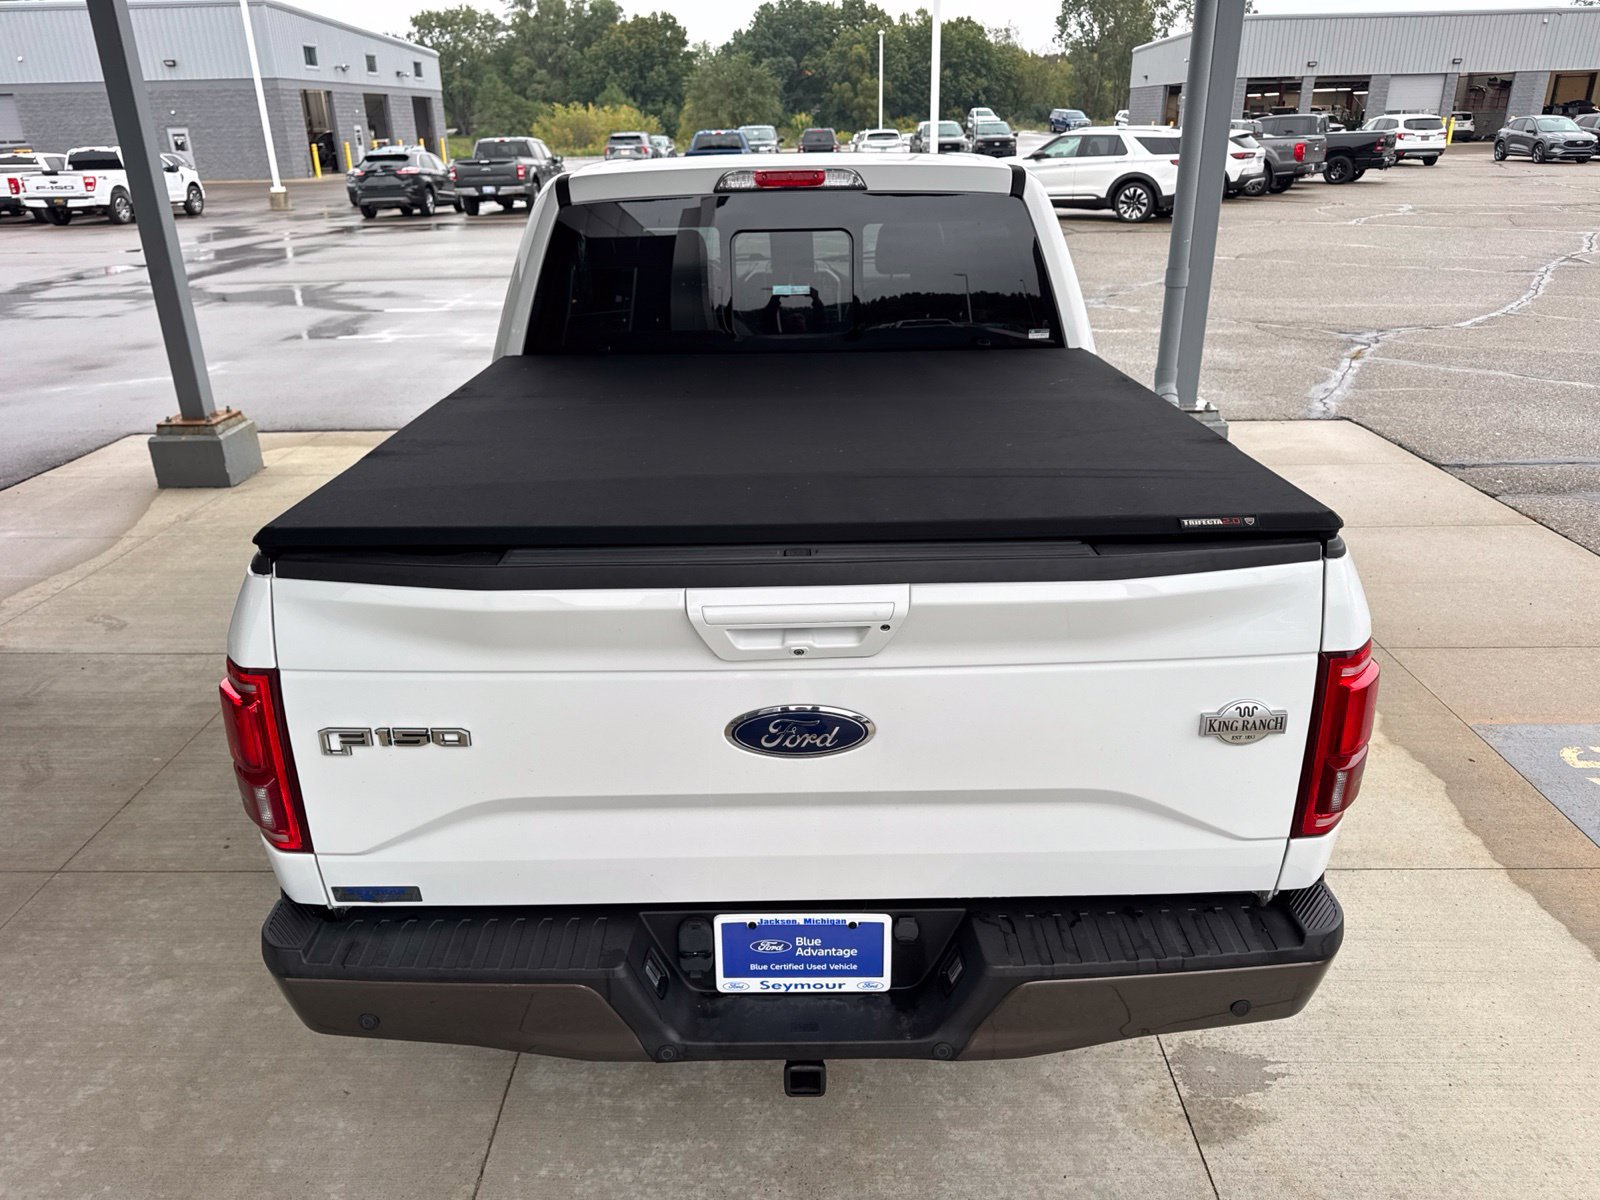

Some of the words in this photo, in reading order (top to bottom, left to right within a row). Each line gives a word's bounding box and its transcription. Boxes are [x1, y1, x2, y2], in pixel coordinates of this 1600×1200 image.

[1207, 718, 1239, 733] KING
[1241, 716, 1284, 731] RANCH
[760, 718, 841, 748] Ford
[757, 918, 799, 926] Jackson,
[803, 918, 847, 926] Michigan
[757, 941, 784, 952] Ford
[795, 937, 822, 946] Blue
[795, 947, 858, 958] Advantage
[769, 962, 804, 970] Certified
[759, 980, 847, 992] Seymour
